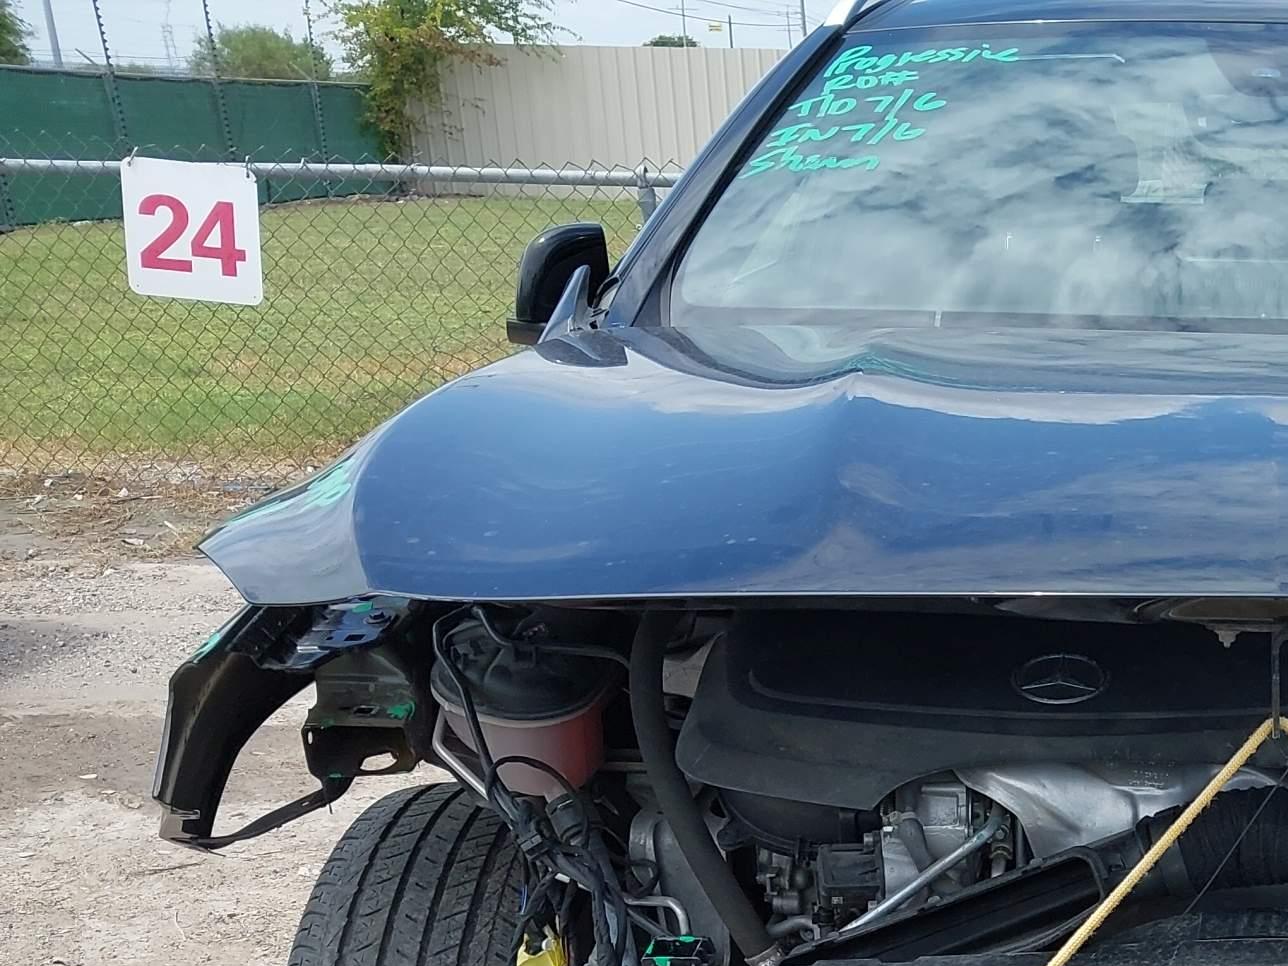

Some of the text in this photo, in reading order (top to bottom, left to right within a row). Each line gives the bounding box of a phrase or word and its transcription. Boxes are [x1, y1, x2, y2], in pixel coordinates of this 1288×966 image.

[864, 89, 947, 121] 7/6
[841, 118, 927, 145] 7/6
[138, 194, 246, 277] 24
